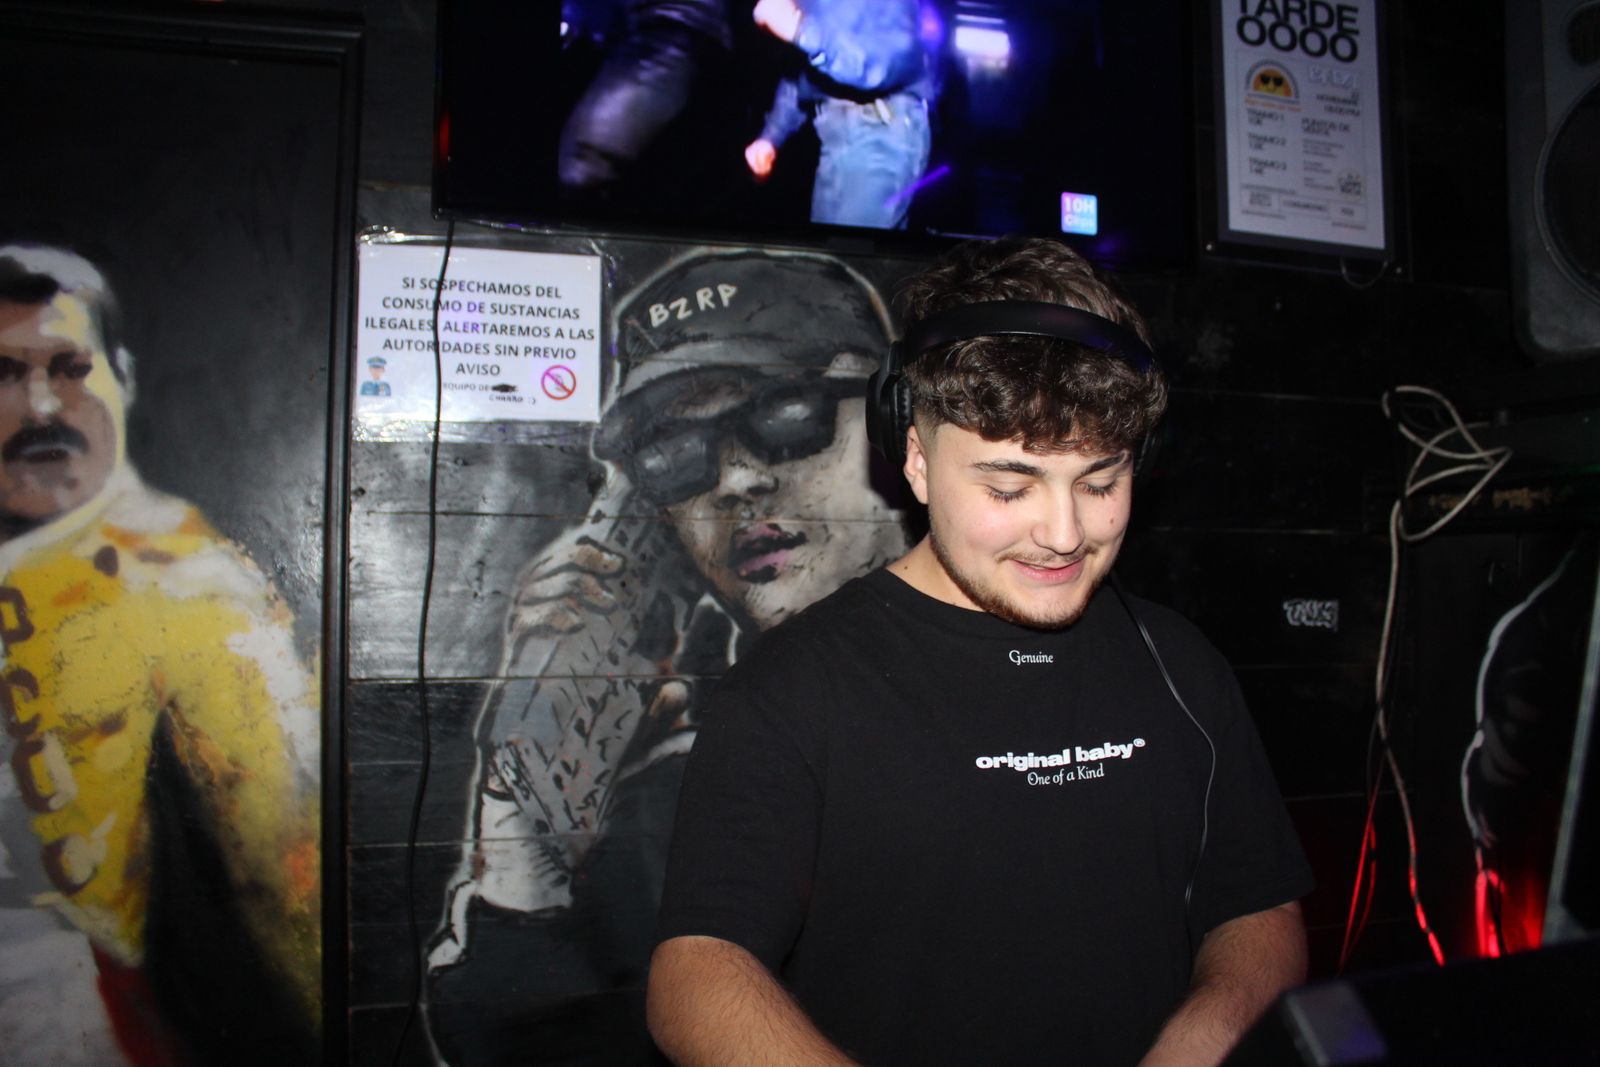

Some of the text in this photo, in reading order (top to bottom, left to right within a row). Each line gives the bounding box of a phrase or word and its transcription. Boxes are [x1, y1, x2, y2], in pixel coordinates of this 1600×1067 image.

[1236, 15, 1358, 63] OOOO
[402, 277, 562, 299] SI SOSPECHAMOS DEL
[382, 296, 580, 320] CONSUMO DE SUSTANCIAS
[649, 283, 737, 328] BZRP
[443, 321, 550, 338] ALERTAREMOS
[555, 328, 565, 339] A
[569, 328, 595, 341] LAS
[383, 339, 576, 360] AUTORDADES SIN PREVIO
[456, 363, 501, 376] AVISO
[1008, 650, 1054, 665] Genuine
[975, 749, 1071, 771] original
[1027, 763, 1105, 786] One of a Kind
